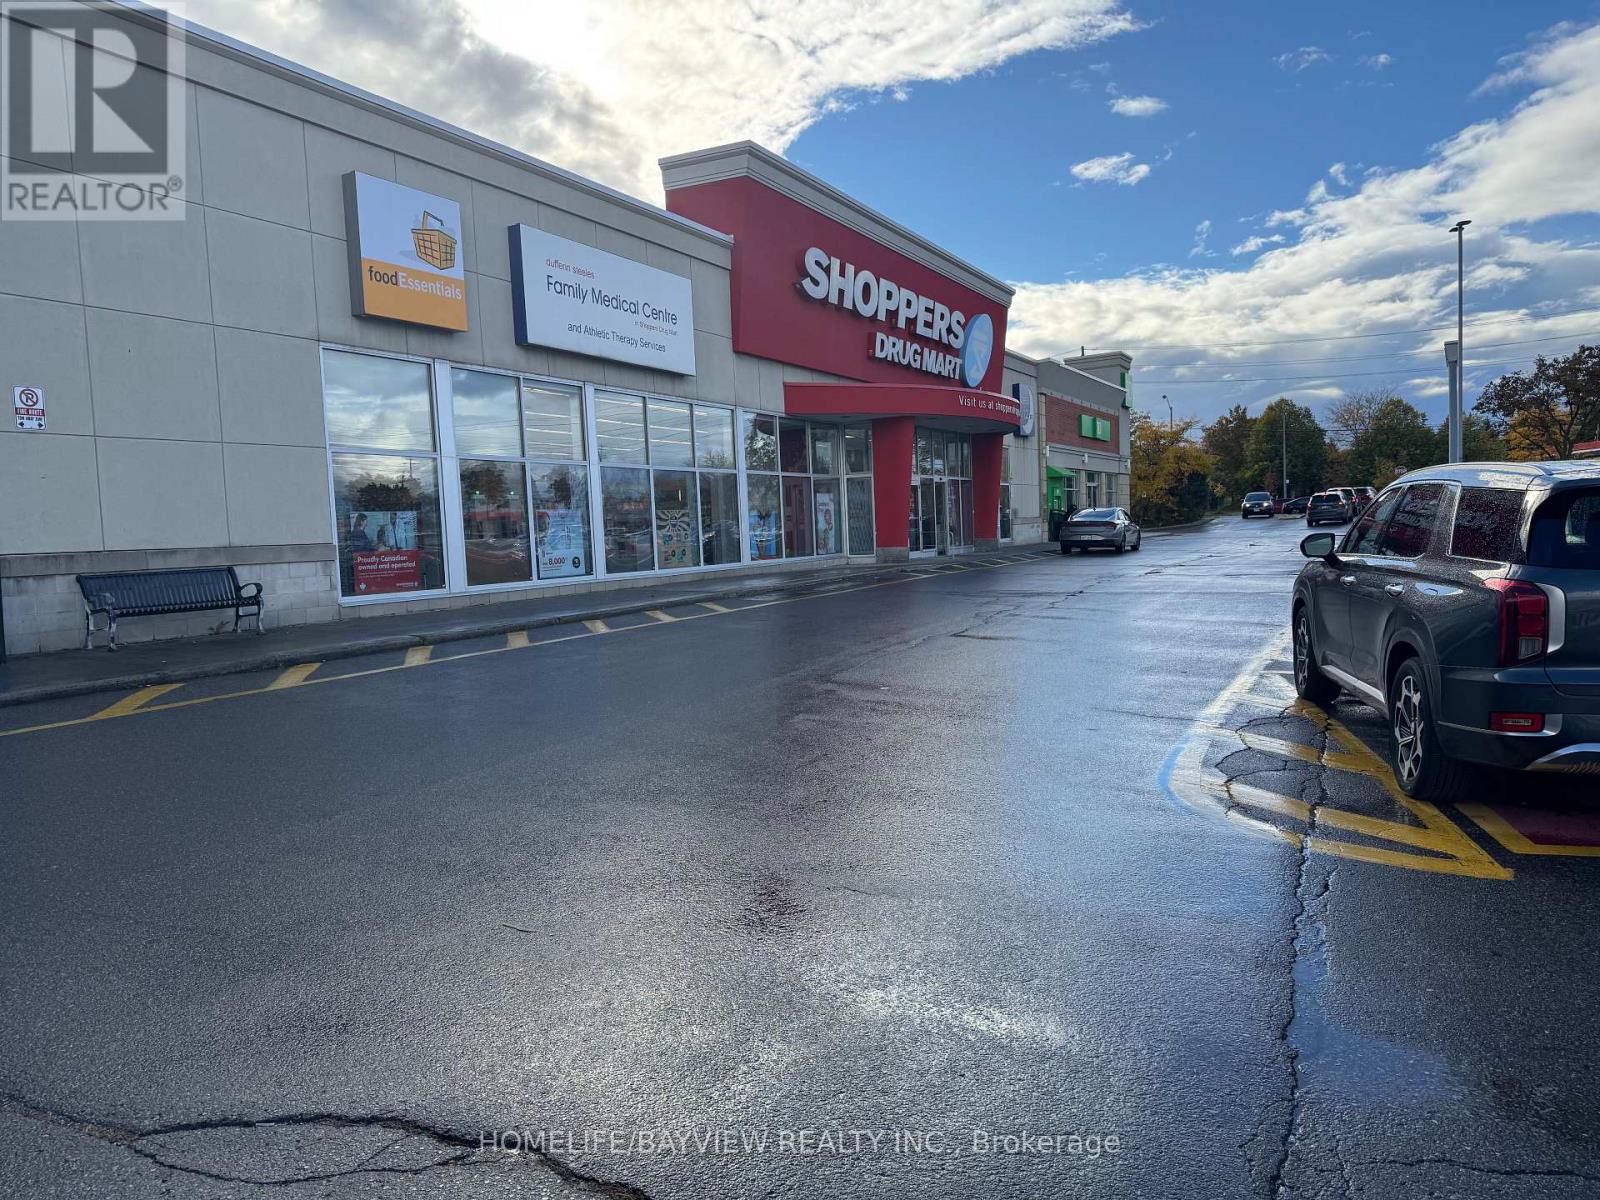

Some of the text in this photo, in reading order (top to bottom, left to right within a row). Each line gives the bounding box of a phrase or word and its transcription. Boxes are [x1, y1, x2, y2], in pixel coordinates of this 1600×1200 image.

[546, 275, 678, 325] Family Medical Centre
[801, 247, 966, 349] SHOPPERS
[567, 322, 666, 352] and Athletic Therapy Services
[875, 331, 963, 380] DRUG MART
[958, 395, 976, 407] Visit
[978, 400, 987, 409] us
[988, 402, 994, 410] at
[357, 554, 408, 563] Proudly Canadian
[358, 562, 378, 570] owned
[391, 561, 416, 569] operated
